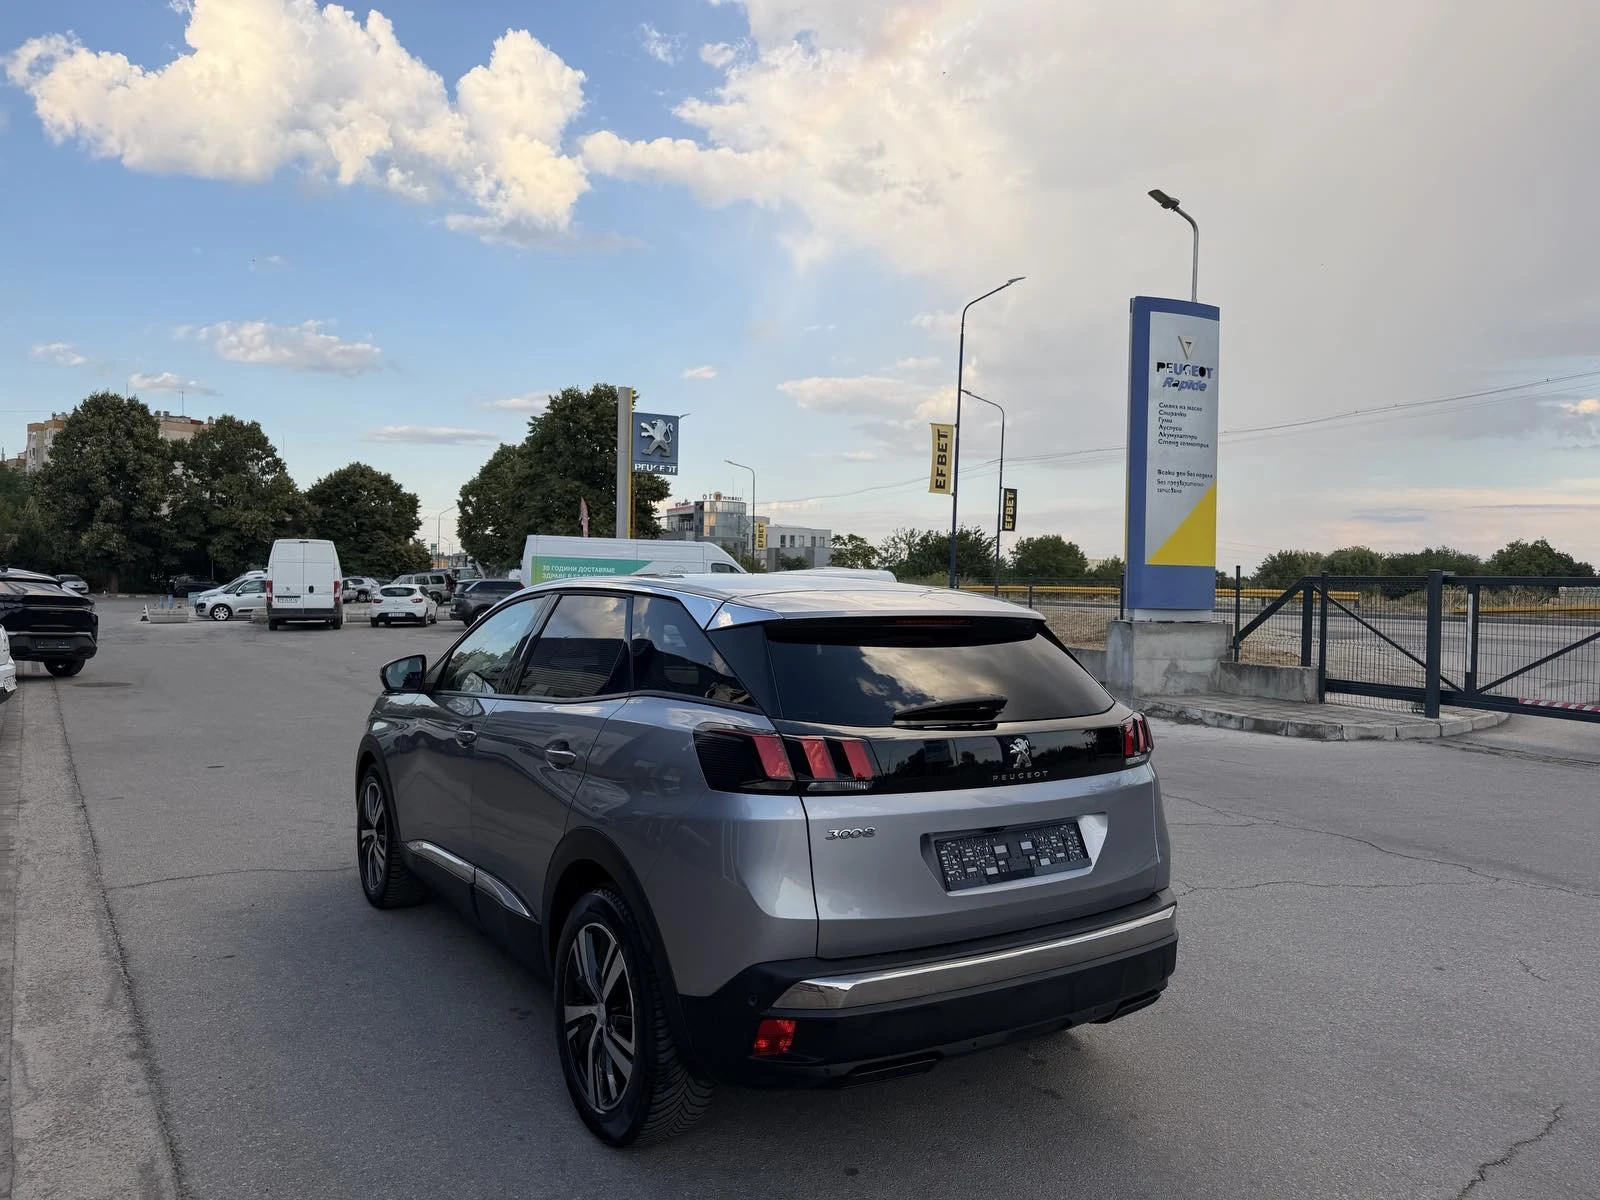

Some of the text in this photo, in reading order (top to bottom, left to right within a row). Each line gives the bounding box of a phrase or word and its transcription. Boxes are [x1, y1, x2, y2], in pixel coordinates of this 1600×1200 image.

[1156, 361, 1214, 379] PEUGEOT
[1162, 377, 1207, 391] Rapide
[934, 429, 949, 489] EFBET
[1004, 492, 1015, 529] EFBET
[551, 565, 578, 573] ГОДИНИ
[992, 770, 1049, 781] PEUGEOT
[824, 827, 876, 840] 3008
